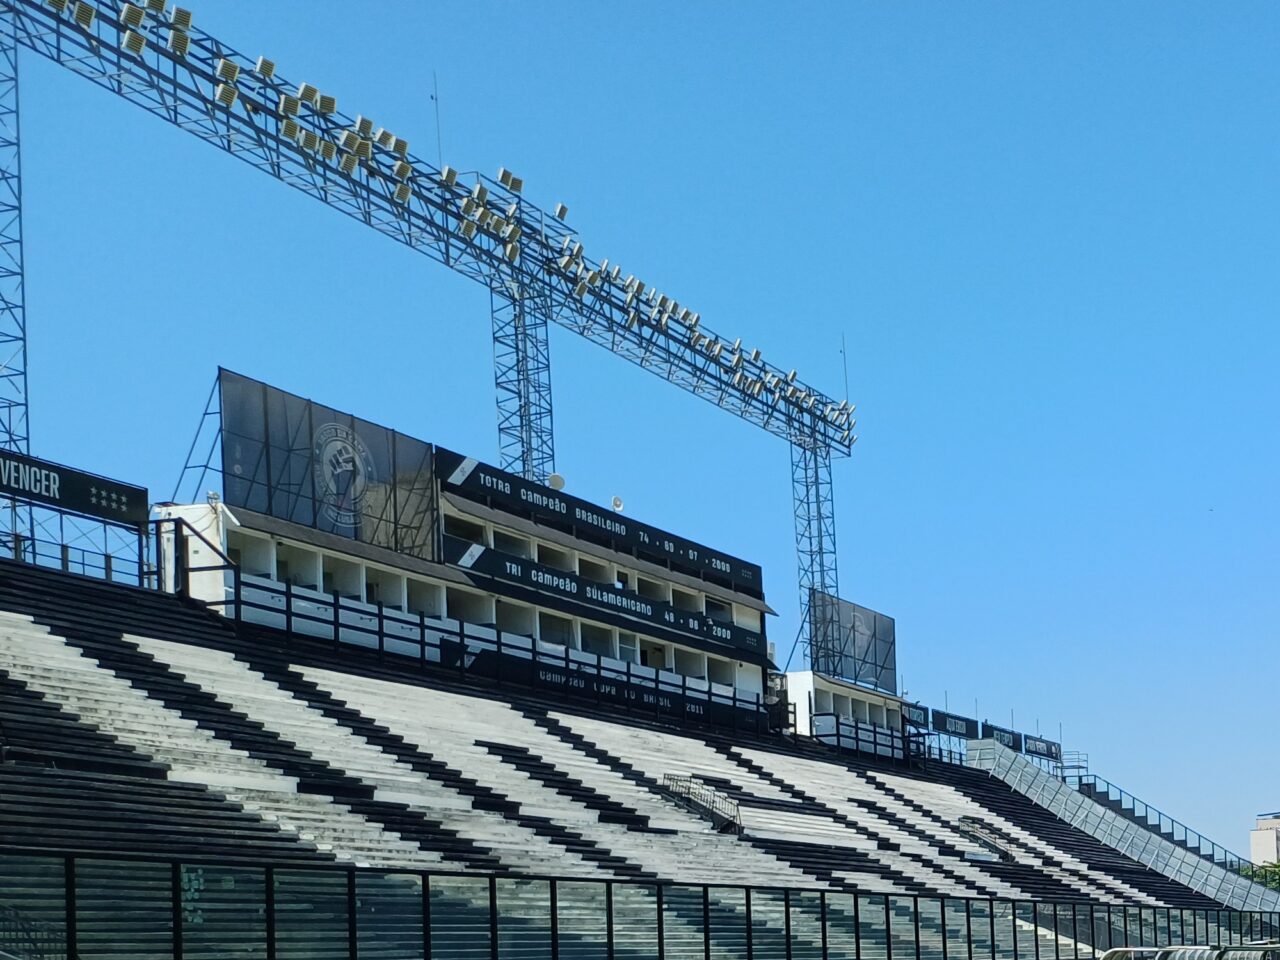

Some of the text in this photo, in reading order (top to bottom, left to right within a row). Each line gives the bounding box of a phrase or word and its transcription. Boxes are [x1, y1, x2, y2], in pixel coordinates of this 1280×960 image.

[0, 457, 60, 499] VENCER
[639, 531, 649, 544] 74
[711, 558, 731, 573] 2000
[505, 561, 521, 577] TRI
[712, 625, 731, 640] 2000
